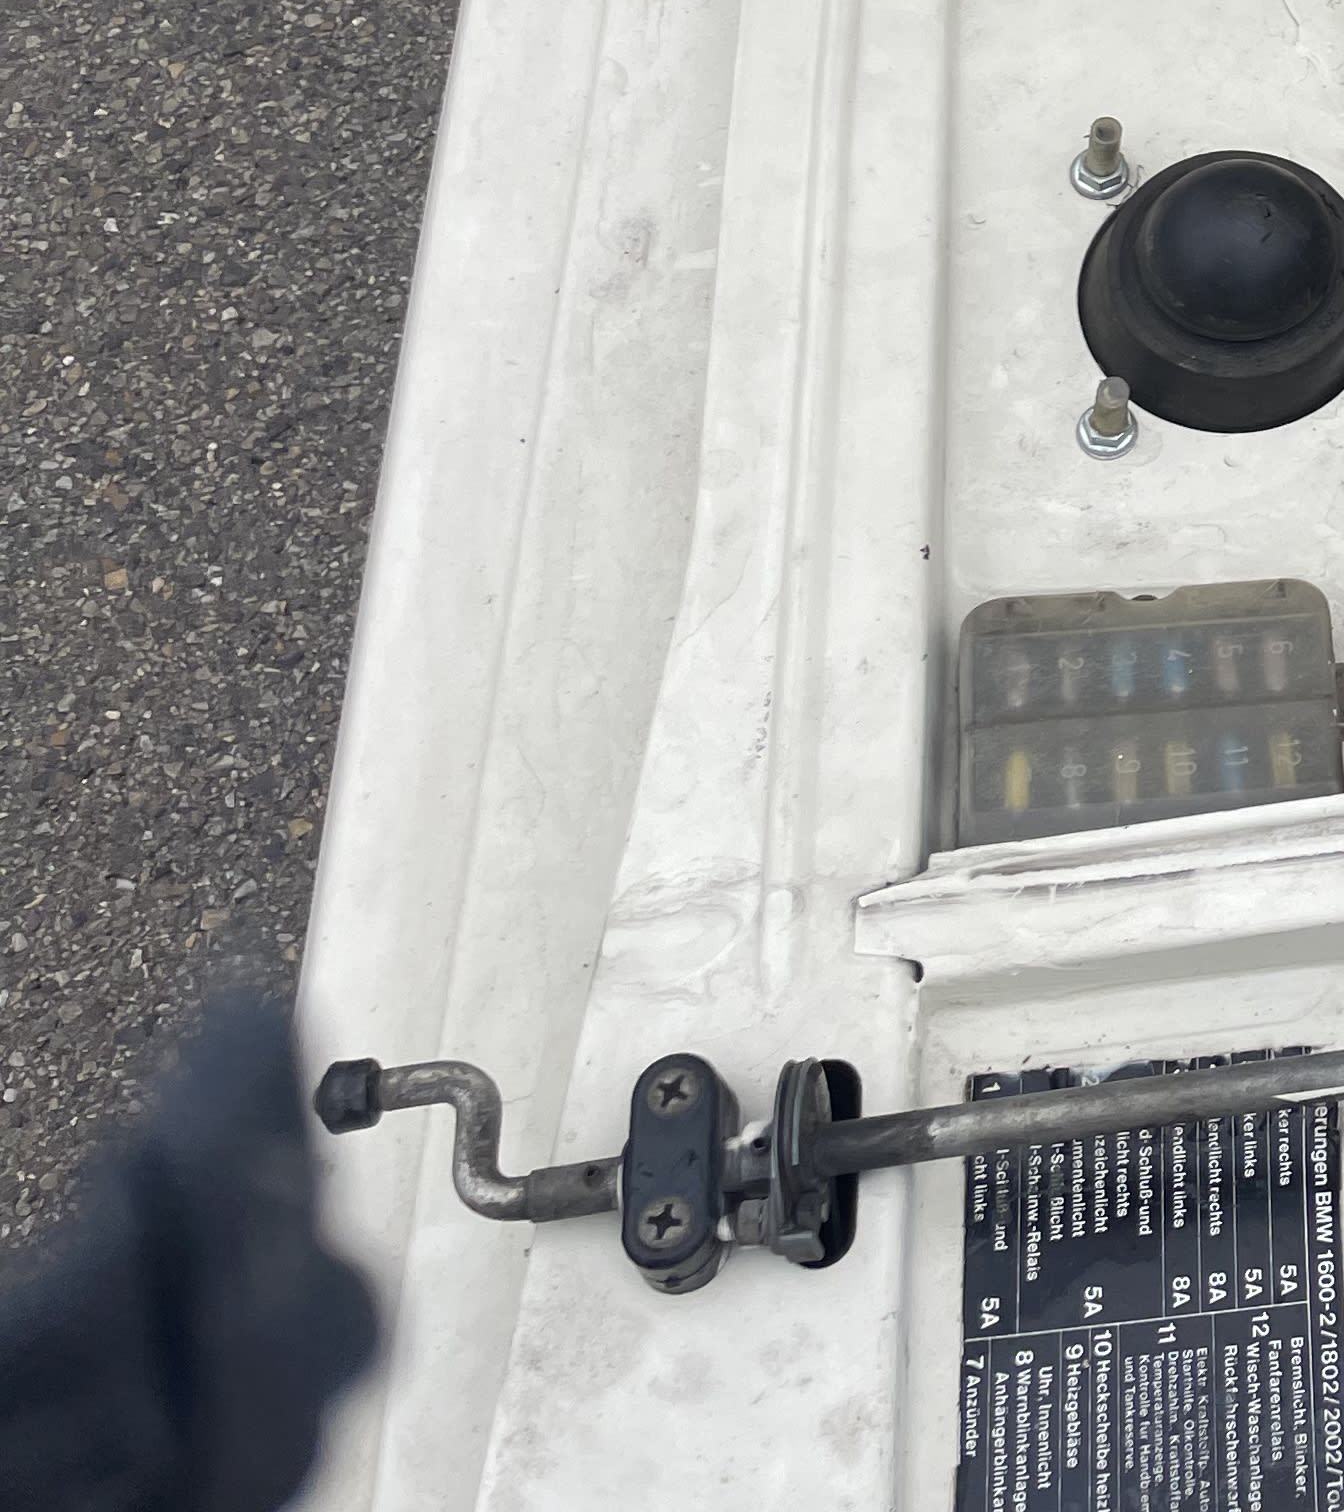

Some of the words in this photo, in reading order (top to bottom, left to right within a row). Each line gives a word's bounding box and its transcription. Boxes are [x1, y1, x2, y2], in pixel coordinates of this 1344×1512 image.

[1058, 656, 1084, 670] 2
[1062, 764, 1087, 778] 8
[1115, 759, 1141, 774] 9
[1223, 746, 1248, 766] 11
[981, 1082, 1001, 1093] 1
[1243, 1112, 1256, 1138] ker
[1278, 1108, 1292, 1134] ker
[1116, 1131, 1130, 1166] licht
[1208, 1117, 1222, 1184] lendlicht
[1244, 1140, 1257, 1178] links
[1310, 1104, 1328, 1186] erungen
[1278, 1138, 1293, 1186] rechts
[974, 1184, 989, 1222] links
[1116, 1168, 1130, 1217] rechts
[1173, 1191, 1187, 1228] links
[1209, 1187, 1223, 1236] rechts
[1314, 1192, 1334, 1242] BMW
[1172, 1276, 1190, 1308] 8A
[1208, 1272, 1226, 1304] 8A
[1244, 1268, 1263, 1300] 5A
[1280, 1264, 1298, 1296] 5A
[980, 1297, 1000, 1329] 5A
[1083, 1286, 1103, 1318] 5A
[1158, 1322, 1176, 1344] 11
[1252, 1312, 1270, 1338] 12
[1015, 1350, 1034, 1366] 8
[1065, 1344, 1084, 1359] 9
[1094, 1330, 1112, 1356] 10
[966, 1355, 984, 1370] 7
[1124, 1357, 1135, 1382] und
[1138, 1354, 1150, 1417] Kontrolle
[965, 1376, 981, 1457] Anzünder
[1064, 1363, 1082, 1468] Heizgebläse
[1096, 1360, 1111, 1470] Heckscheibe
[1013, 1368, 1032, 1512] Warnblinkanlage
[1037, 1404, 1052, 1490] Innenlicht
